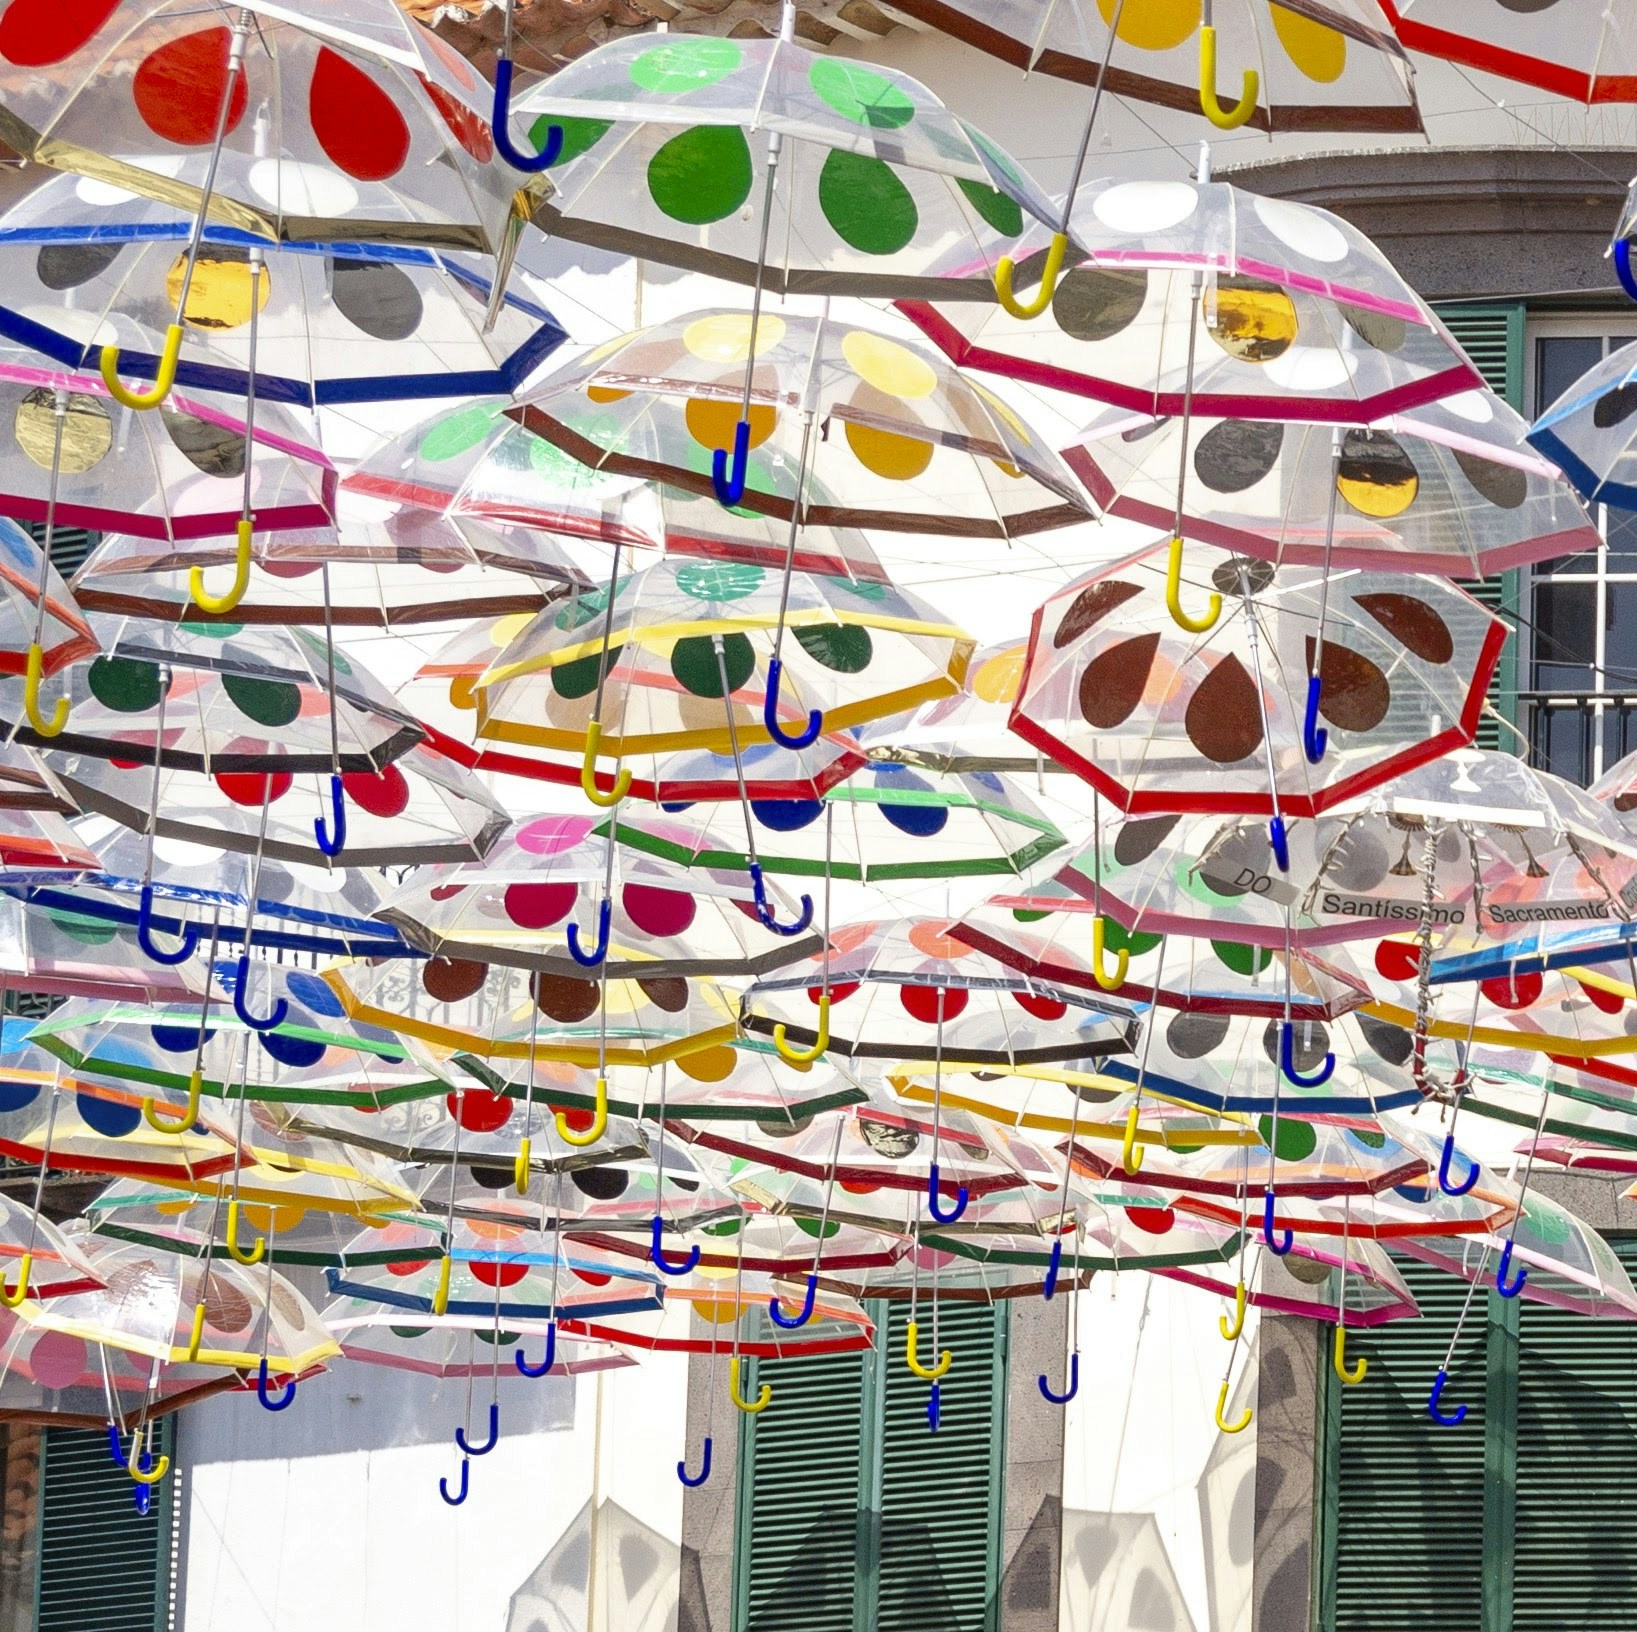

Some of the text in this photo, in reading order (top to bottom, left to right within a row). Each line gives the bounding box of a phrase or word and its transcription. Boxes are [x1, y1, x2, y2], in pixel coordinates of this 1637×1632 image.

[1233, 867, 1272, 894] DO
[1322, 893, 1466, 924] Santíssimo
[1489, 900, 1609, 924] Sacramento
